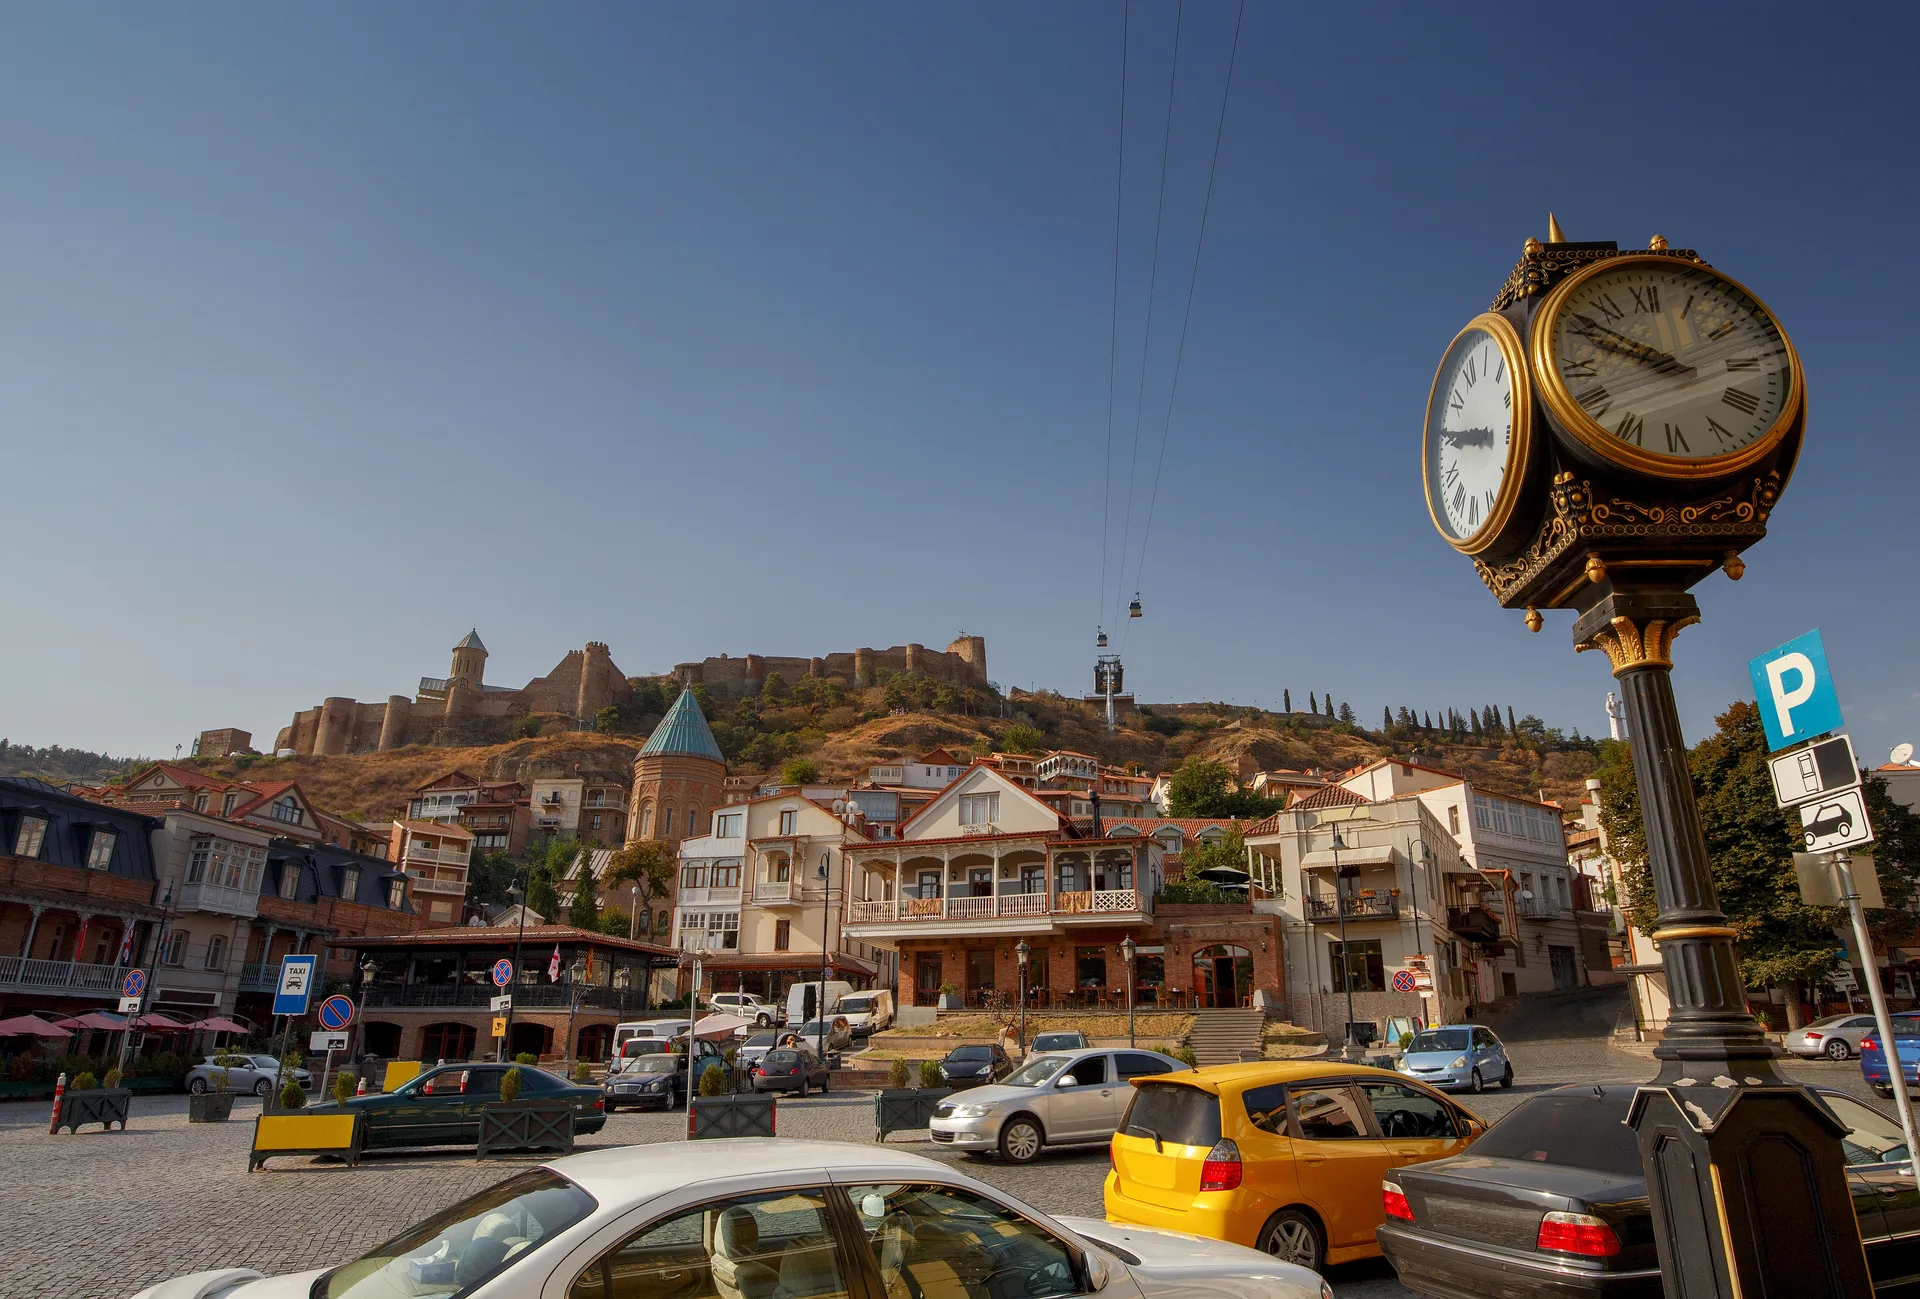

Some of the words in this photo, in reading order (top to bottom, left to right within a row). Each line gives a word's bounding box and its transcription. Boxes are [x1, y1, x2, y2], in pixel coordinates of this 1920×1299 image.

[1589, 293, 1625, 325] XI
[1628, 286, 1660, 313] XII
[1680, 295, 1694, 320] I
[1708, 321, 1739, 342] II
[1462, 356, 1477, 394] XII
[1561, 358, 1597, 378] IX
[1725, 357, 1762, 373] III
[1450, 389, 1464, 418] XI
[1574, 384, 1614, 422] VIII
[1721, 387, 1761, 416] IIII
[1614, 411, 1644, 446] VII
[1663, 422, 1692, 453] VI
[1705, 415, 1734, 443] V
[1445, 459, 1459, 488] IX
[1452, 481, 1467, 519] VIII
[1468, 495, 1480, 525] VII
[1765, 652, 1816, 738] P
[289, 967, 306, 975] TAXI
